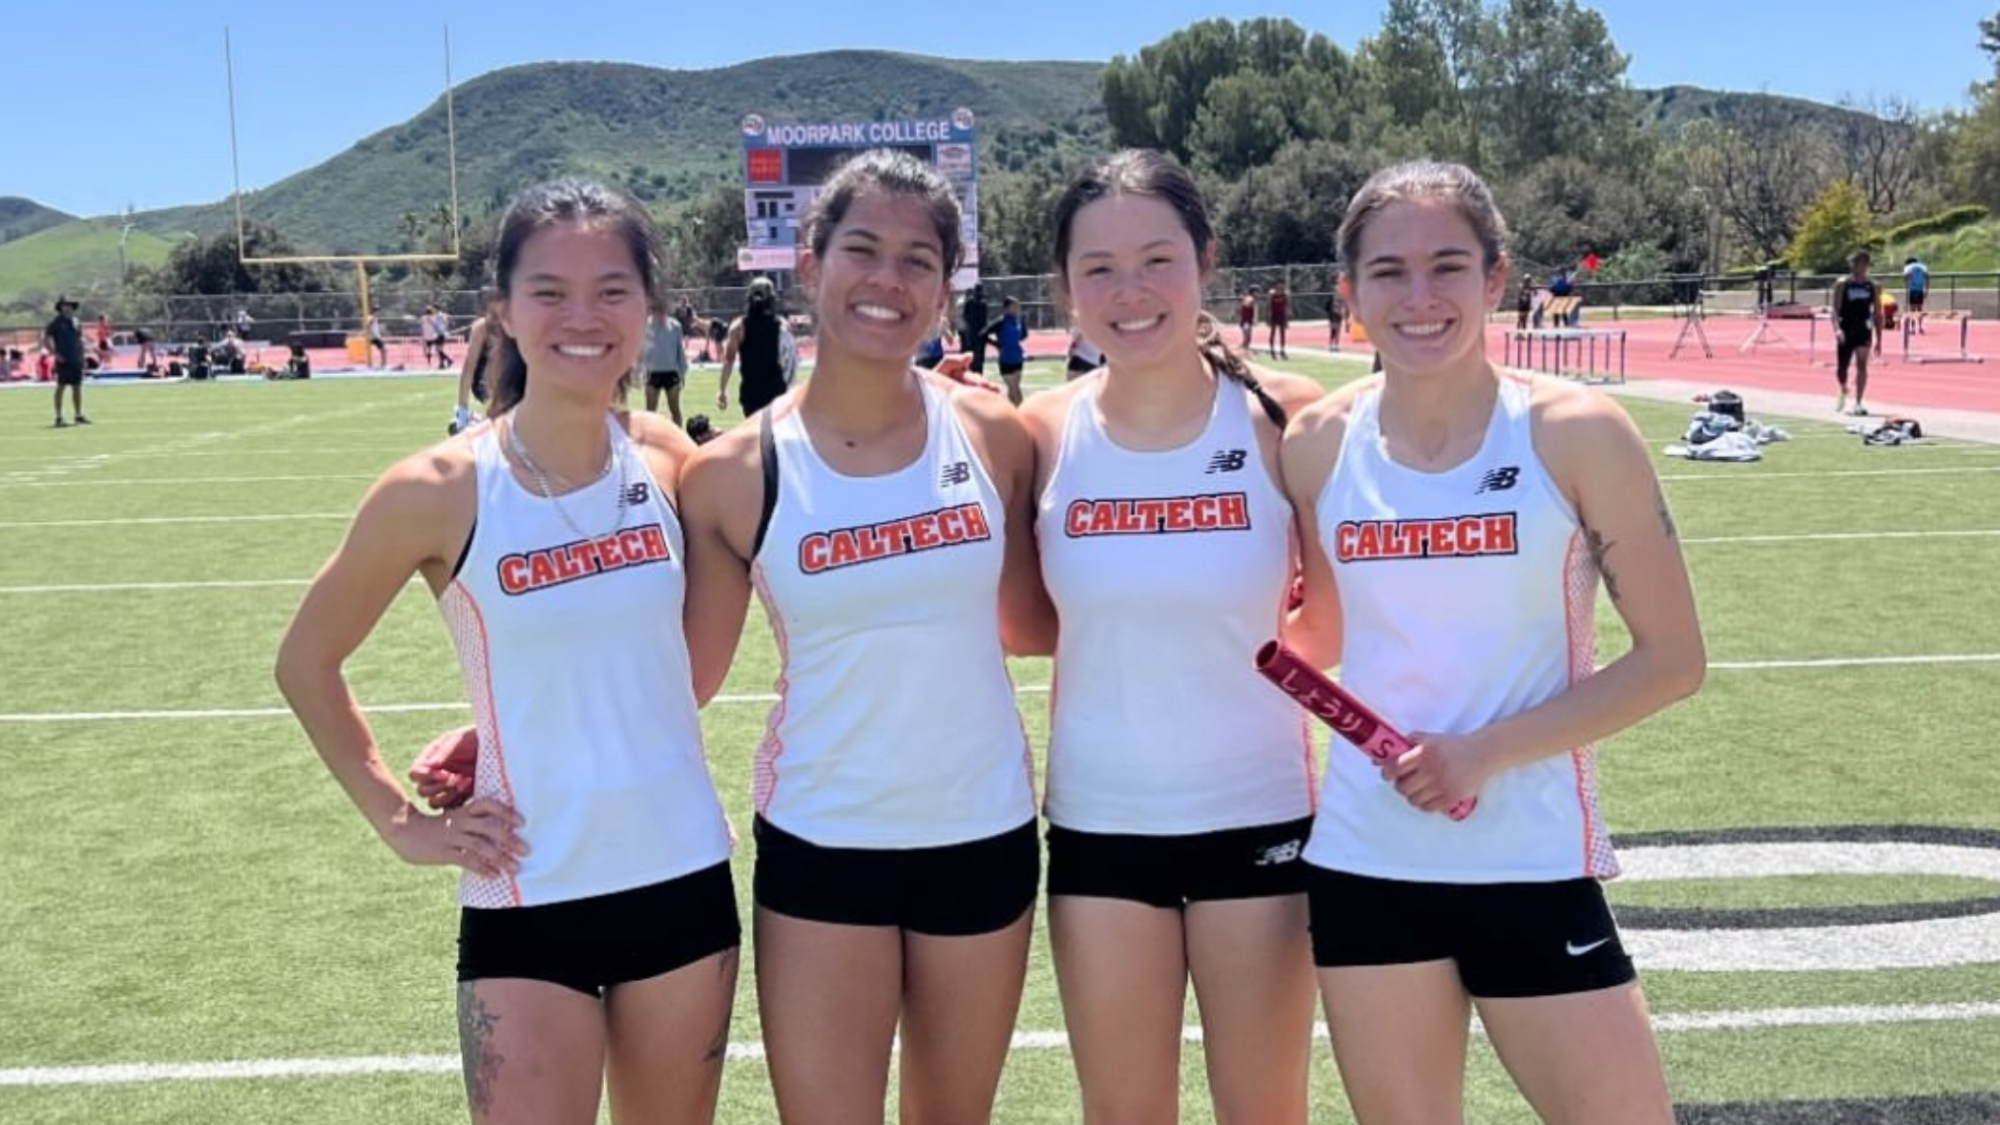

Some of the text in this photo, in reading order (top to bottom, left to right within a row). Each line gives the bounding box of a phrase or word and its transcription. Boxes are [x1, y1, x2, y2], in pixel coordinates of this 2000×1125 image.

[767, 123, 865, 145] MOORPARK
[869, 121, 950, 143] COLLEGE
[799, 502, 990, 574] CALTECH
[1065, 492, 1251, 538] CALTECH
[1336, 511, 1518, 563] CALTECH
[497, 523, 670, 596] CALTECH
